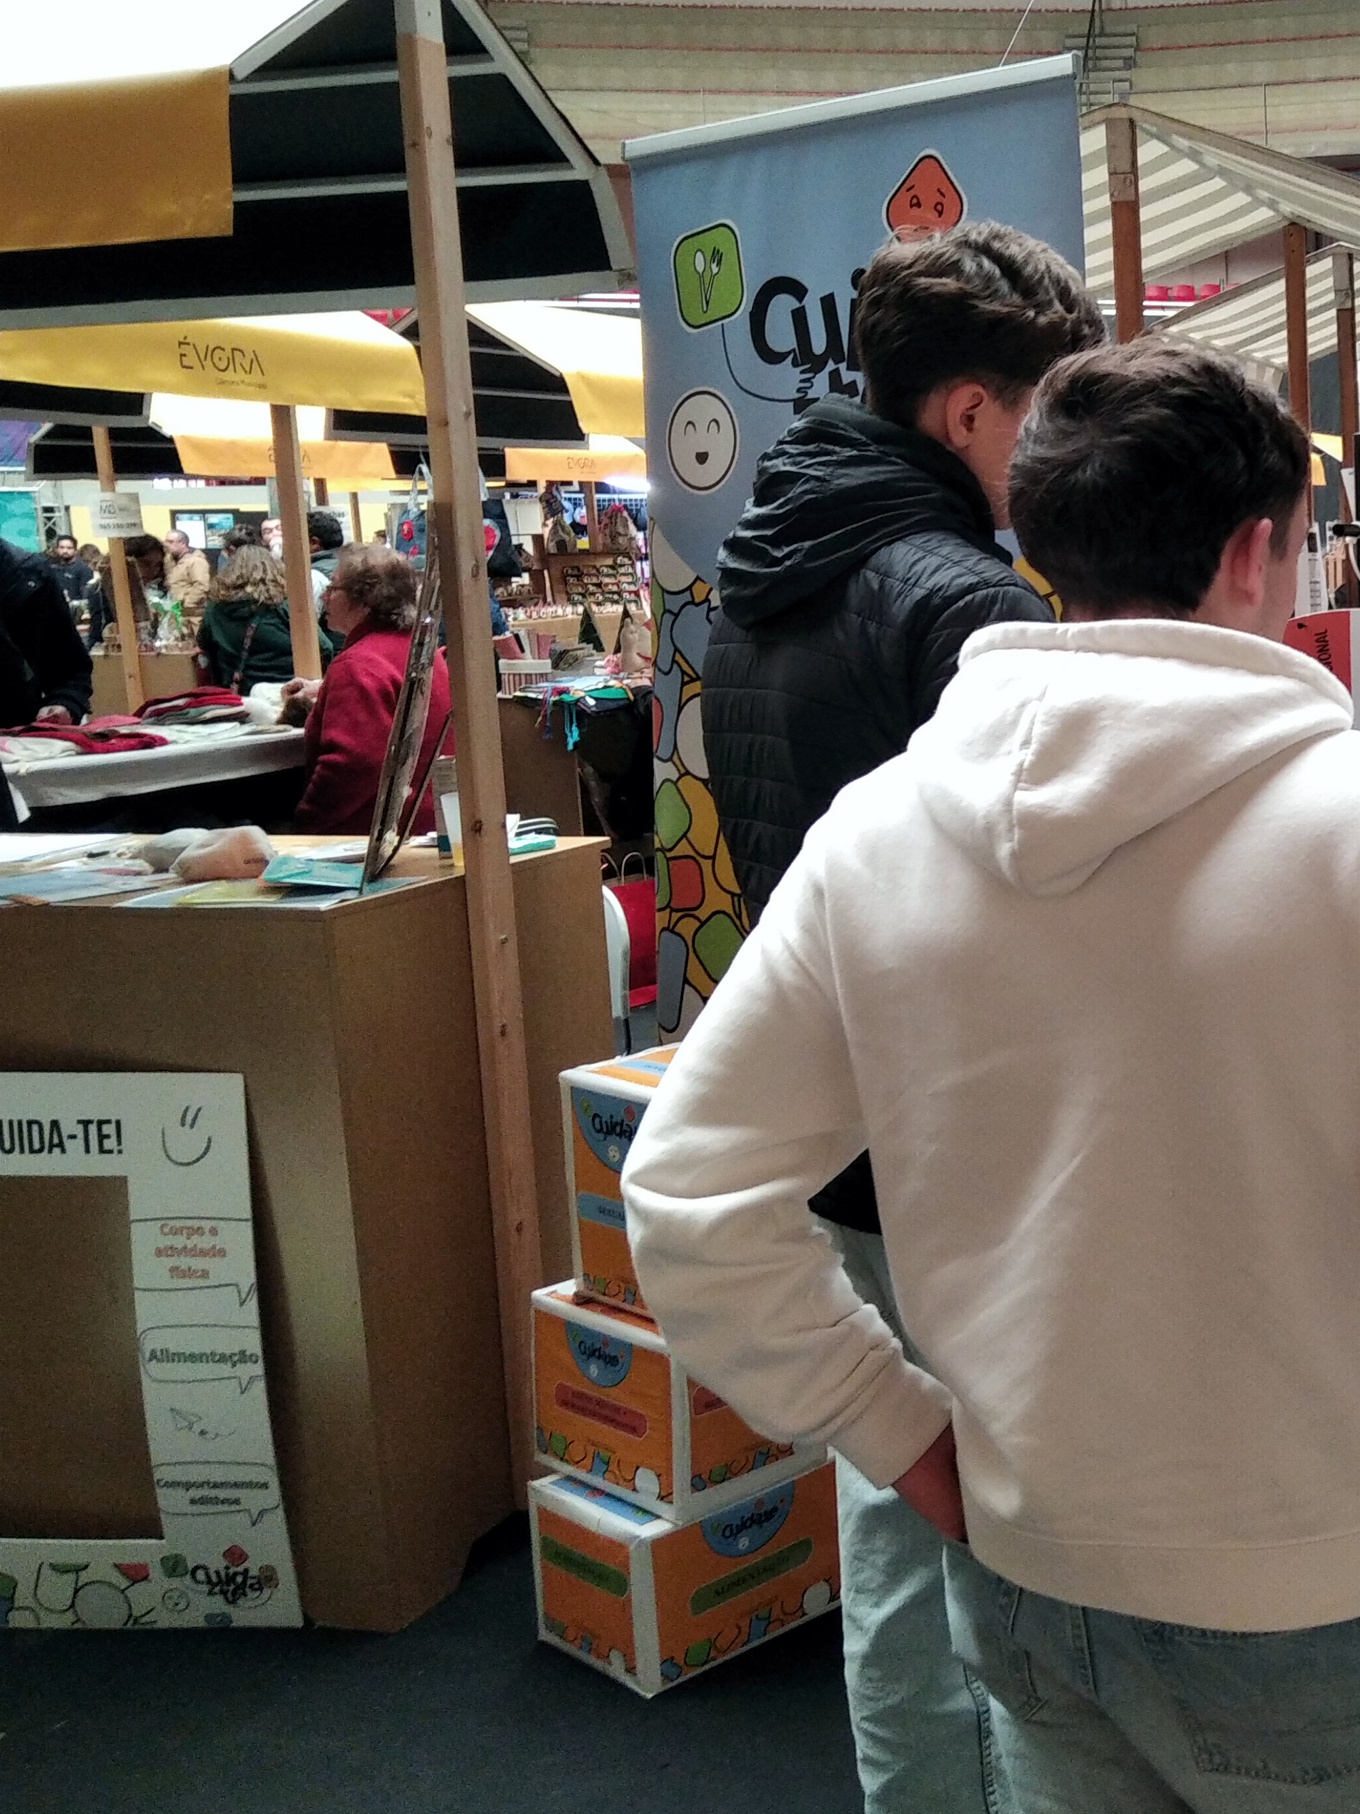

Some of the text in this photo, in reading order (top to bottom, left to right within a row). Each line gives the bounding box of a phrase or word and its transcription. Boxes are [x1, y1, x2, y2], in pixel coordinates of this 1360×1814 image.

[178, 335, 265, 377] ÉVORA
[160, 1223, 205, 1240] Corpo
[154, 1244, 227, 1258] atividade
[148, 1348, 259, 1368] Alimentação
[156, 1478, 269, 1492] Comportamentos
